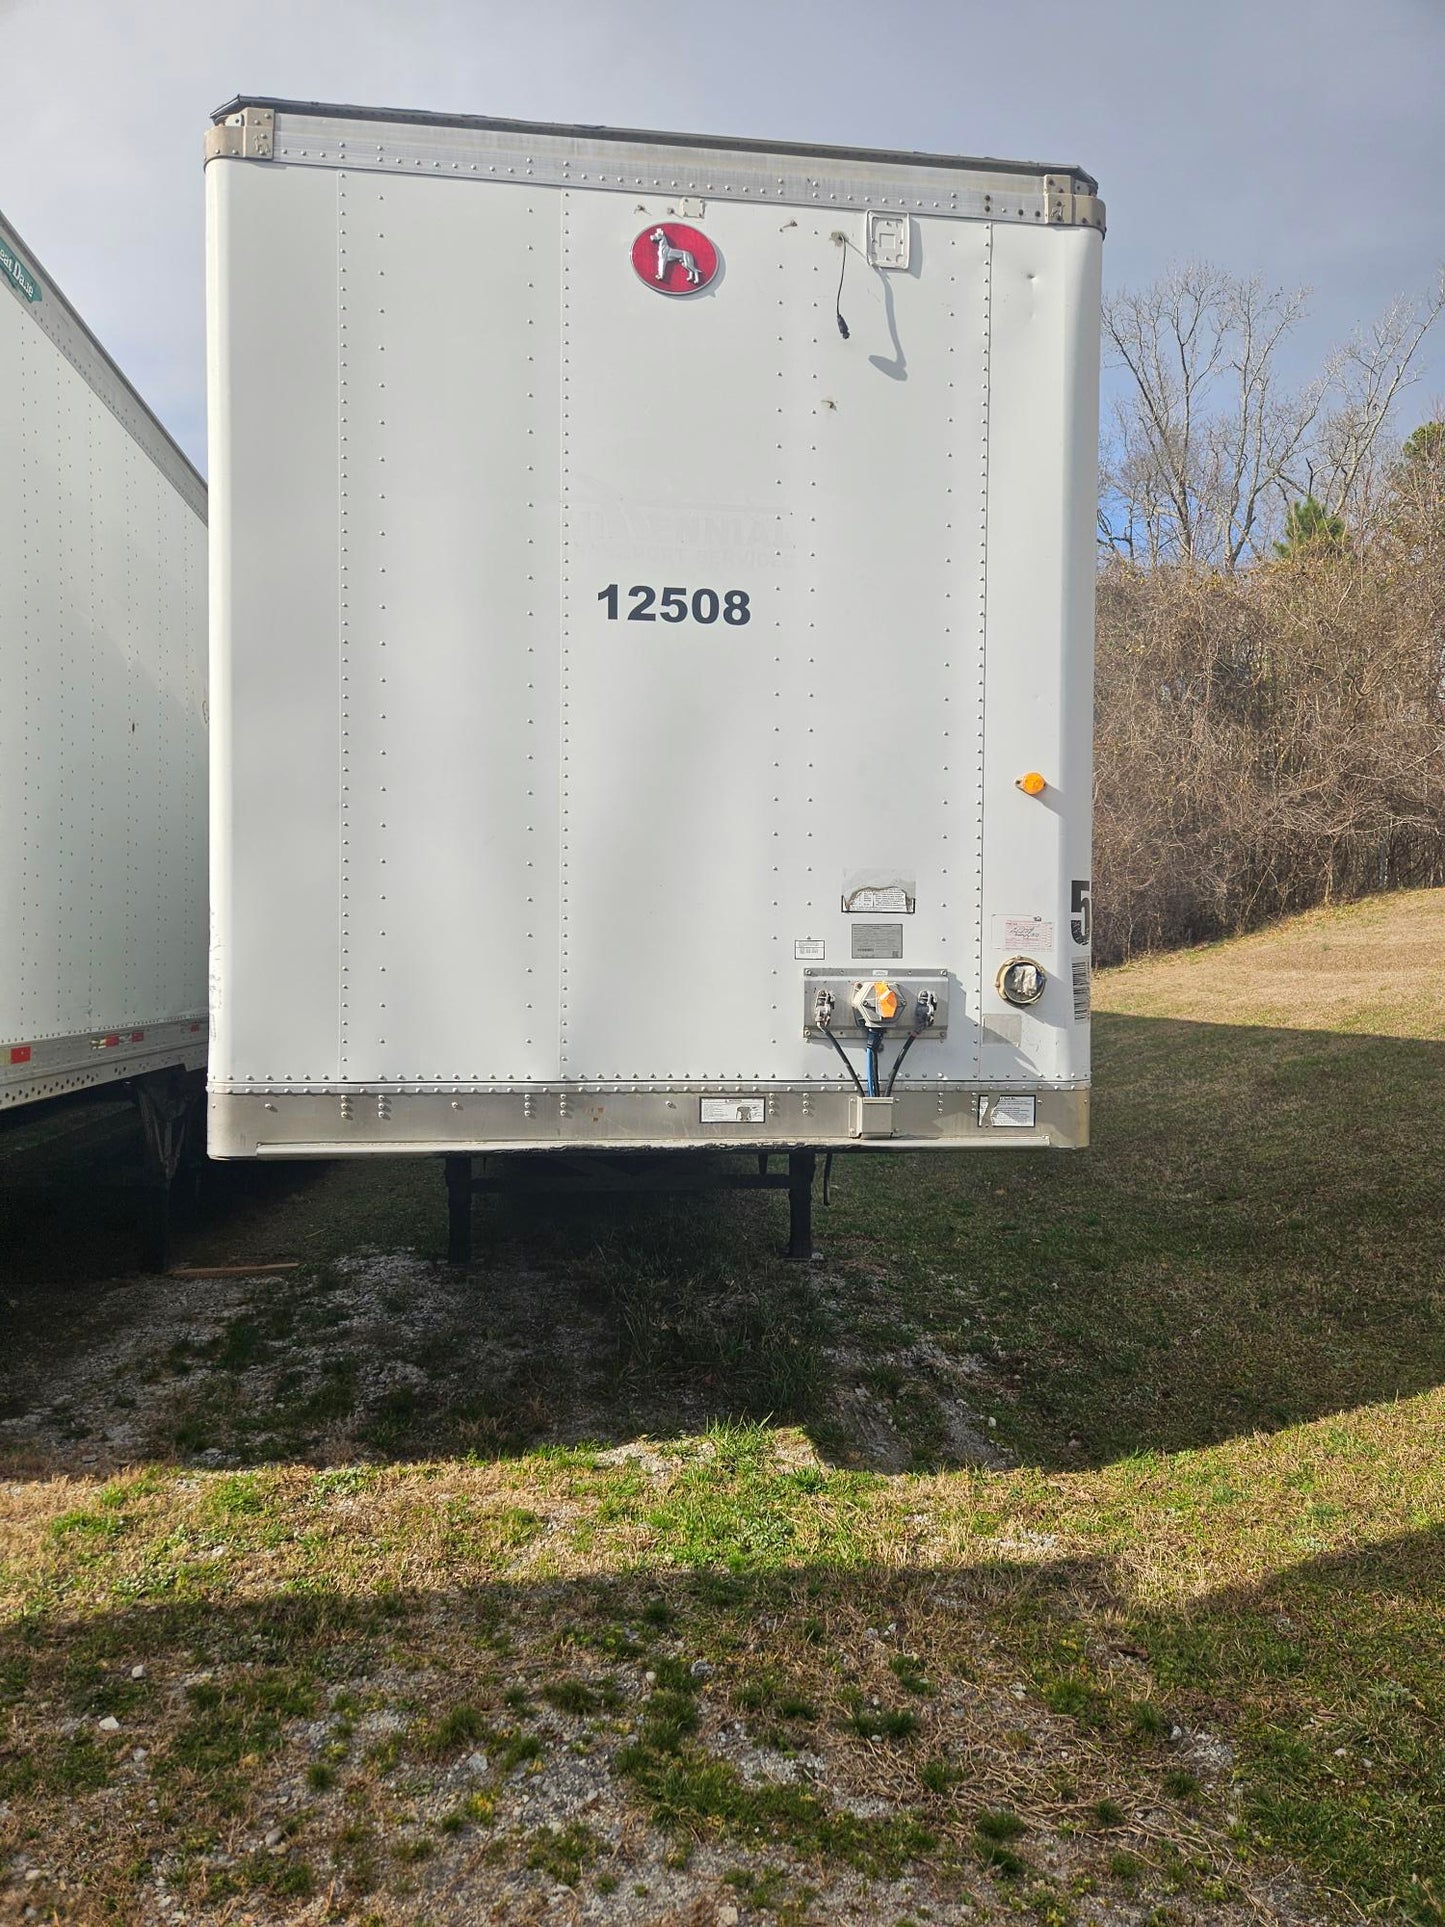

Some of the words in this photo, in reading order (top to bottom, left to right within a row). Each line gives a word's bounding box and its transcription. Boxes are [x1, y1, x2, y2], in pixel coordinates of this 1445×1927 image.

[13, 261, 35, 298] Dane
[597, 584, 751, 626] 12508
[1070, 880, 1091, 946] 5
